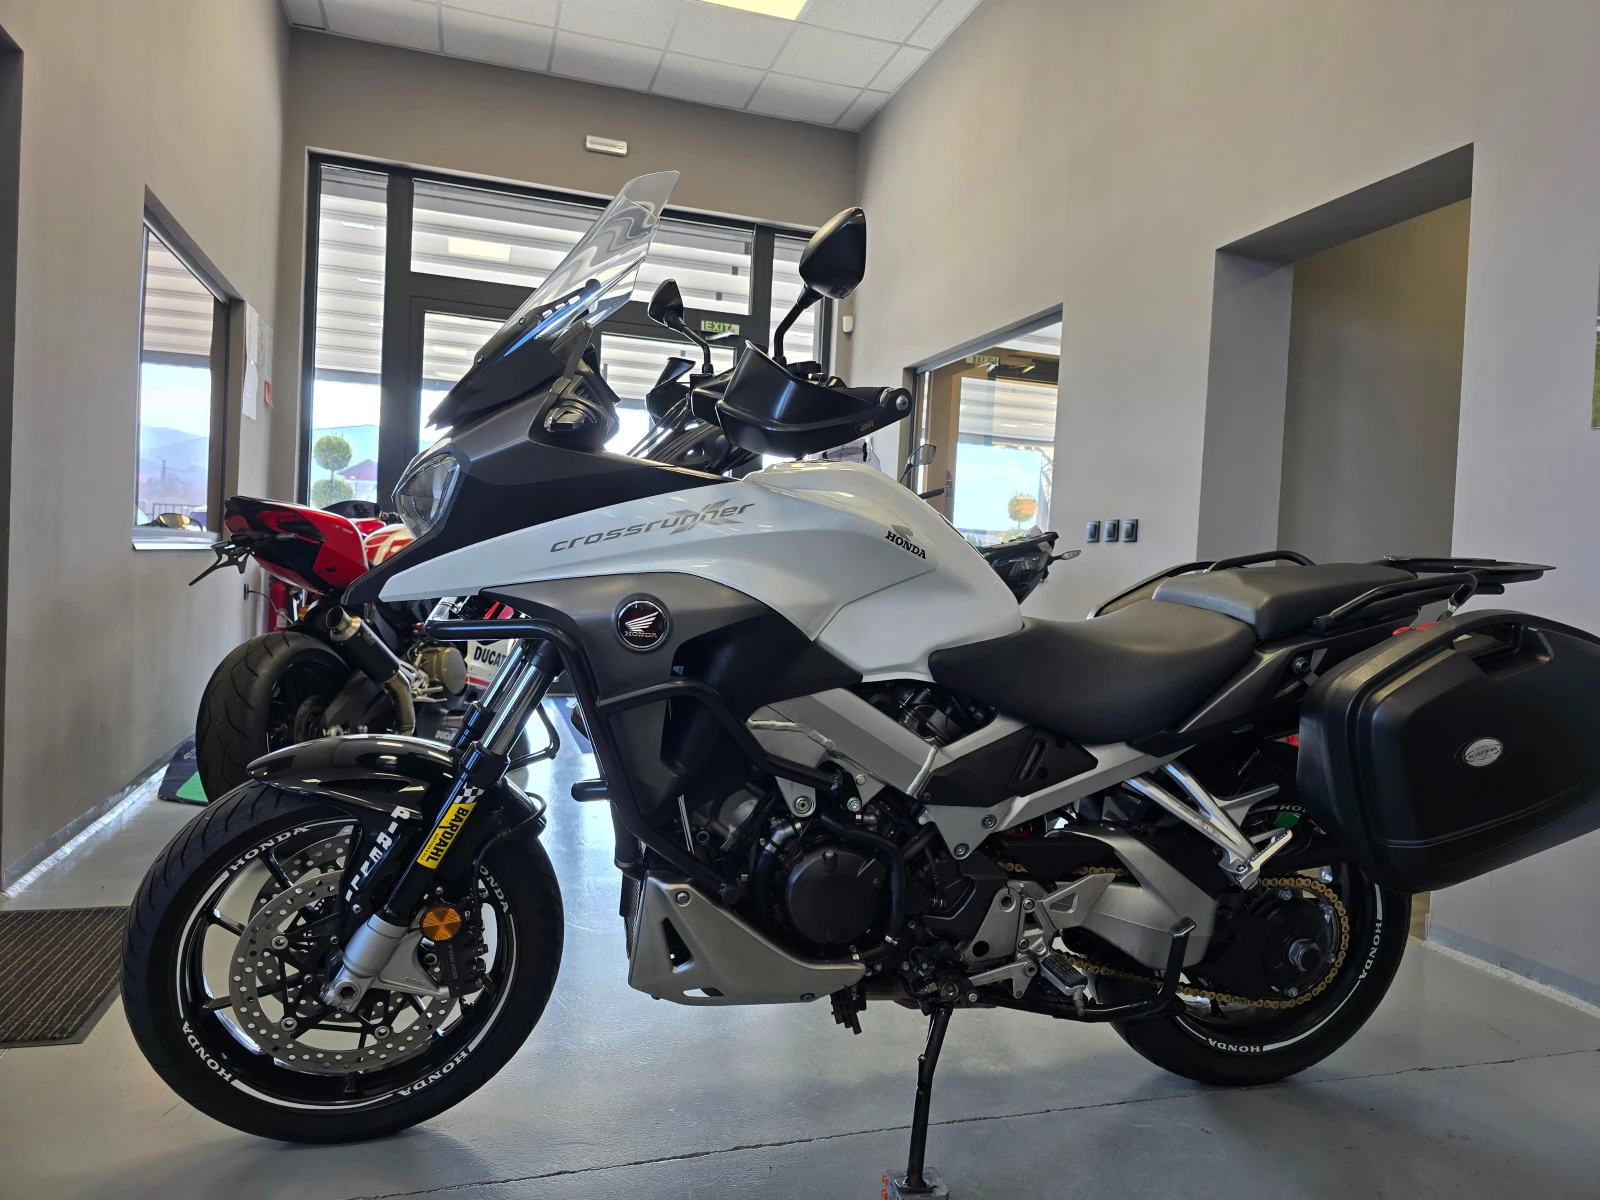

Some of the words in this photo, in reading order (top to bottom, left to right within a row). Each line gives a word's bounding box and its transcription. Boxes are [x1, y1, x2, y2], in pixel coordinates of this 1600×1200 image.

[705, 320, 731, 332] EXIT
[550, 502, 756, 553] crossrunner
[885, 530, 927, 560] HONDA
[624, 630, 659, 638] HONDA
[229, 826, 311, 872] HONDA
[345, 805, 411, 902] PIRELLI
[425, 806, 470, 863] BARDAHL
[447, 943, 458, 980] TOKICO
[1358, 921, 1383, 980] HONDA
[182, 1020, 233, 1082] HONDA
[1207, 1037, 1261, 1053] HONDA
[397, 1050, 469, 1097] HONDA
